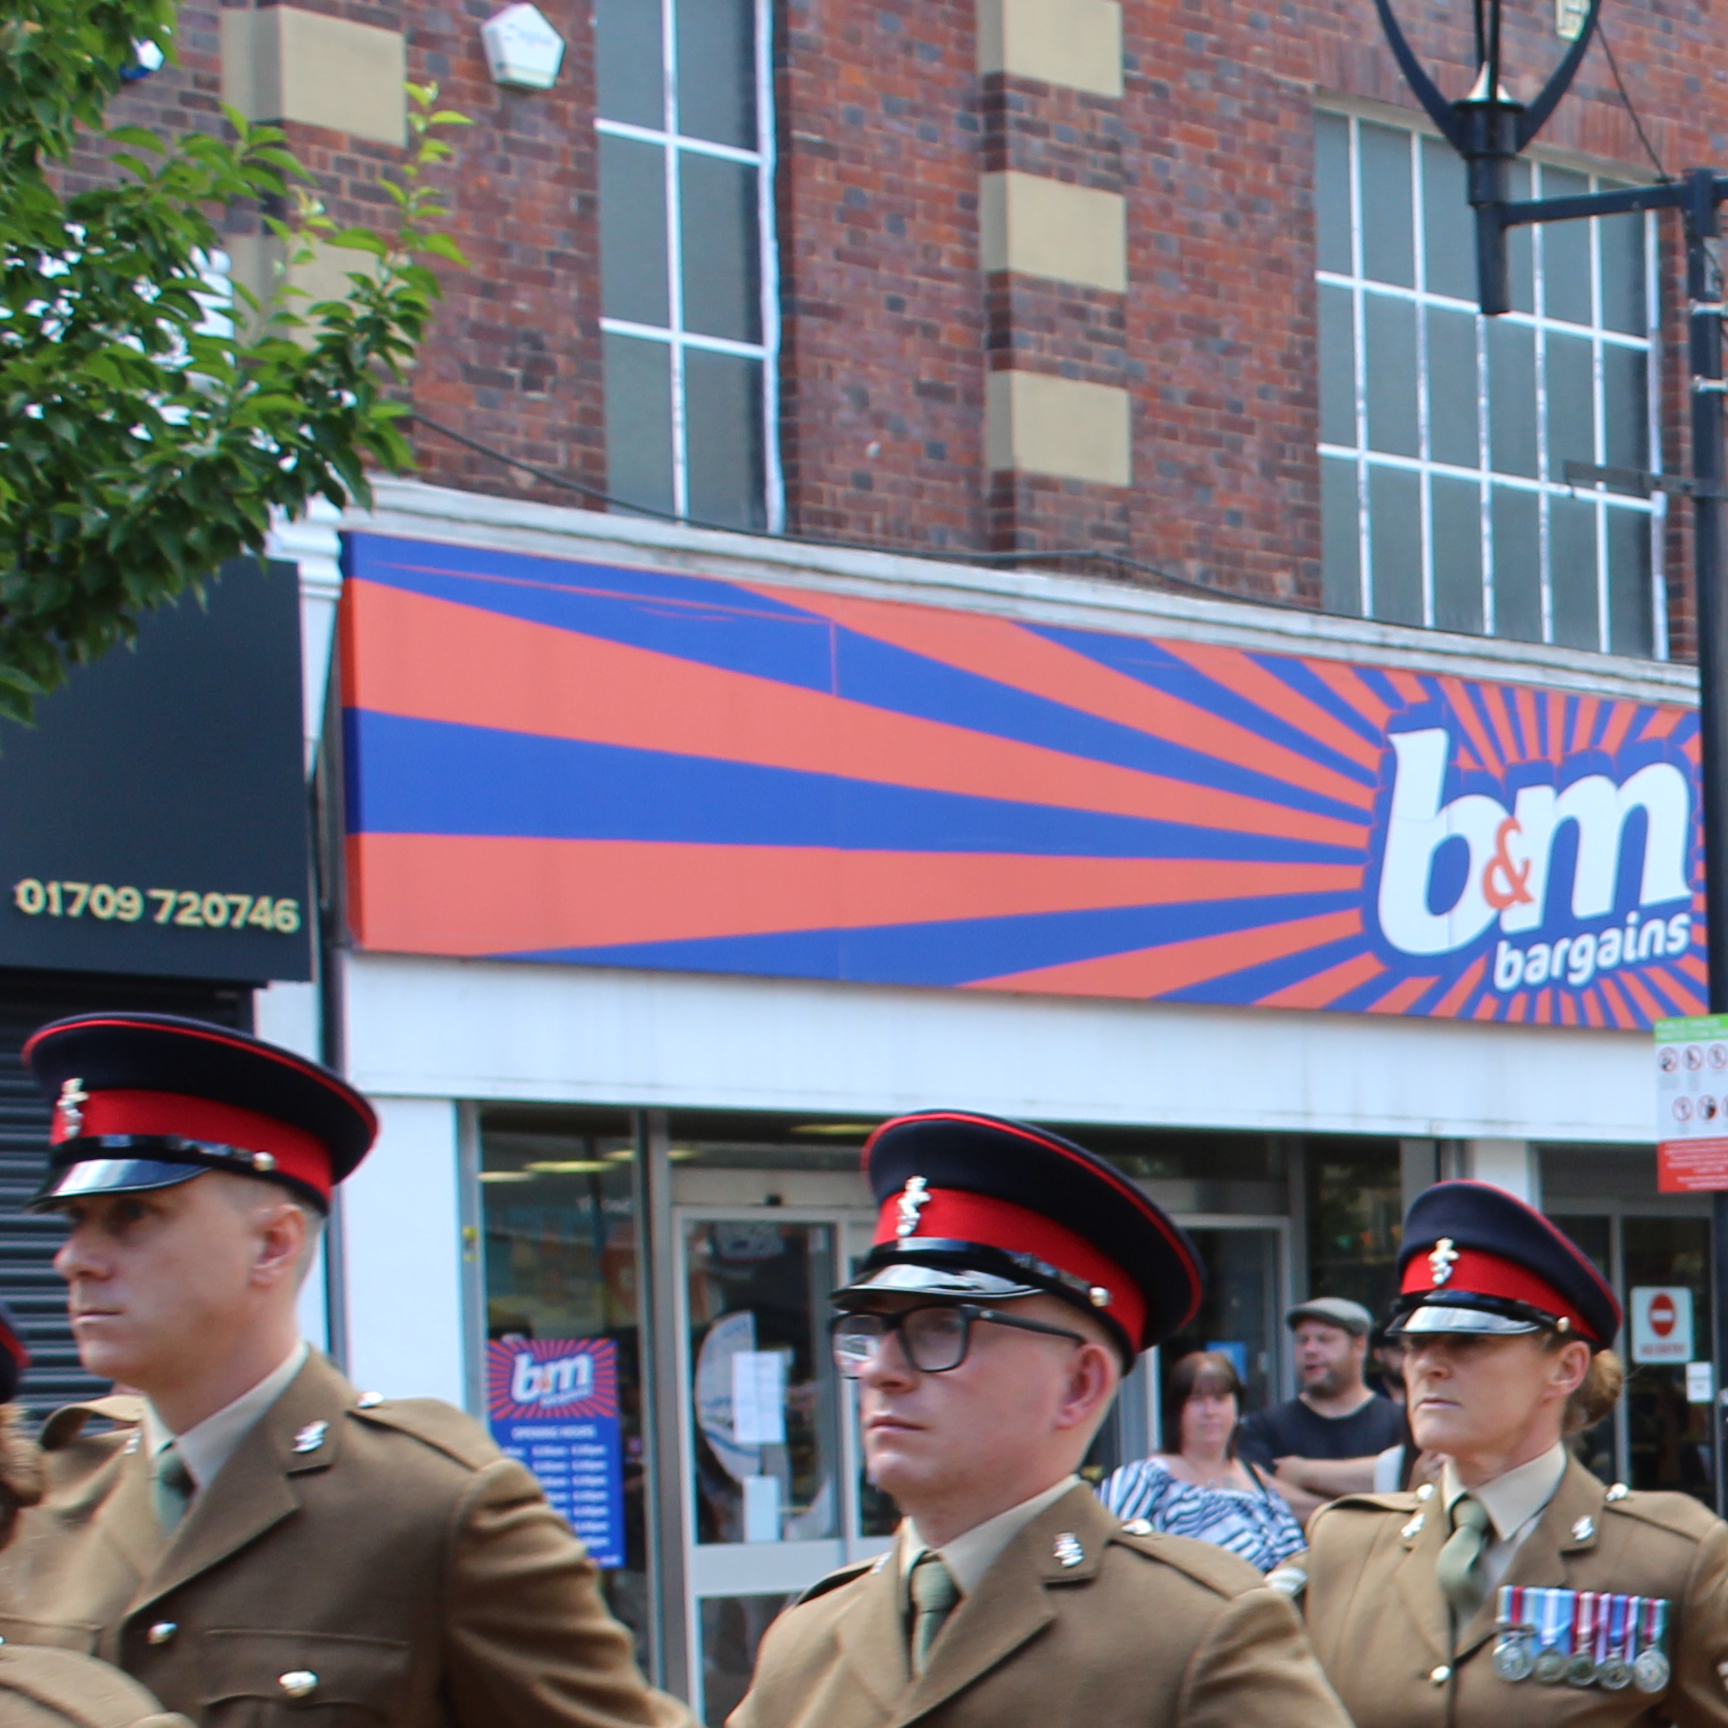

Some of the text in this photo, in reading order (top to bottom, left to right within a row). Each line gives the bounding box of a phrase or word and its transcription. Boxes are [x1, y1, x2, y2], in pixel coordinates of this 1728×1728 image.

[1378, 728, 1693, 956] b&m
[15, 878, 300, 934] 01709 720746
[1493, 911, 1692, 992] bargains
